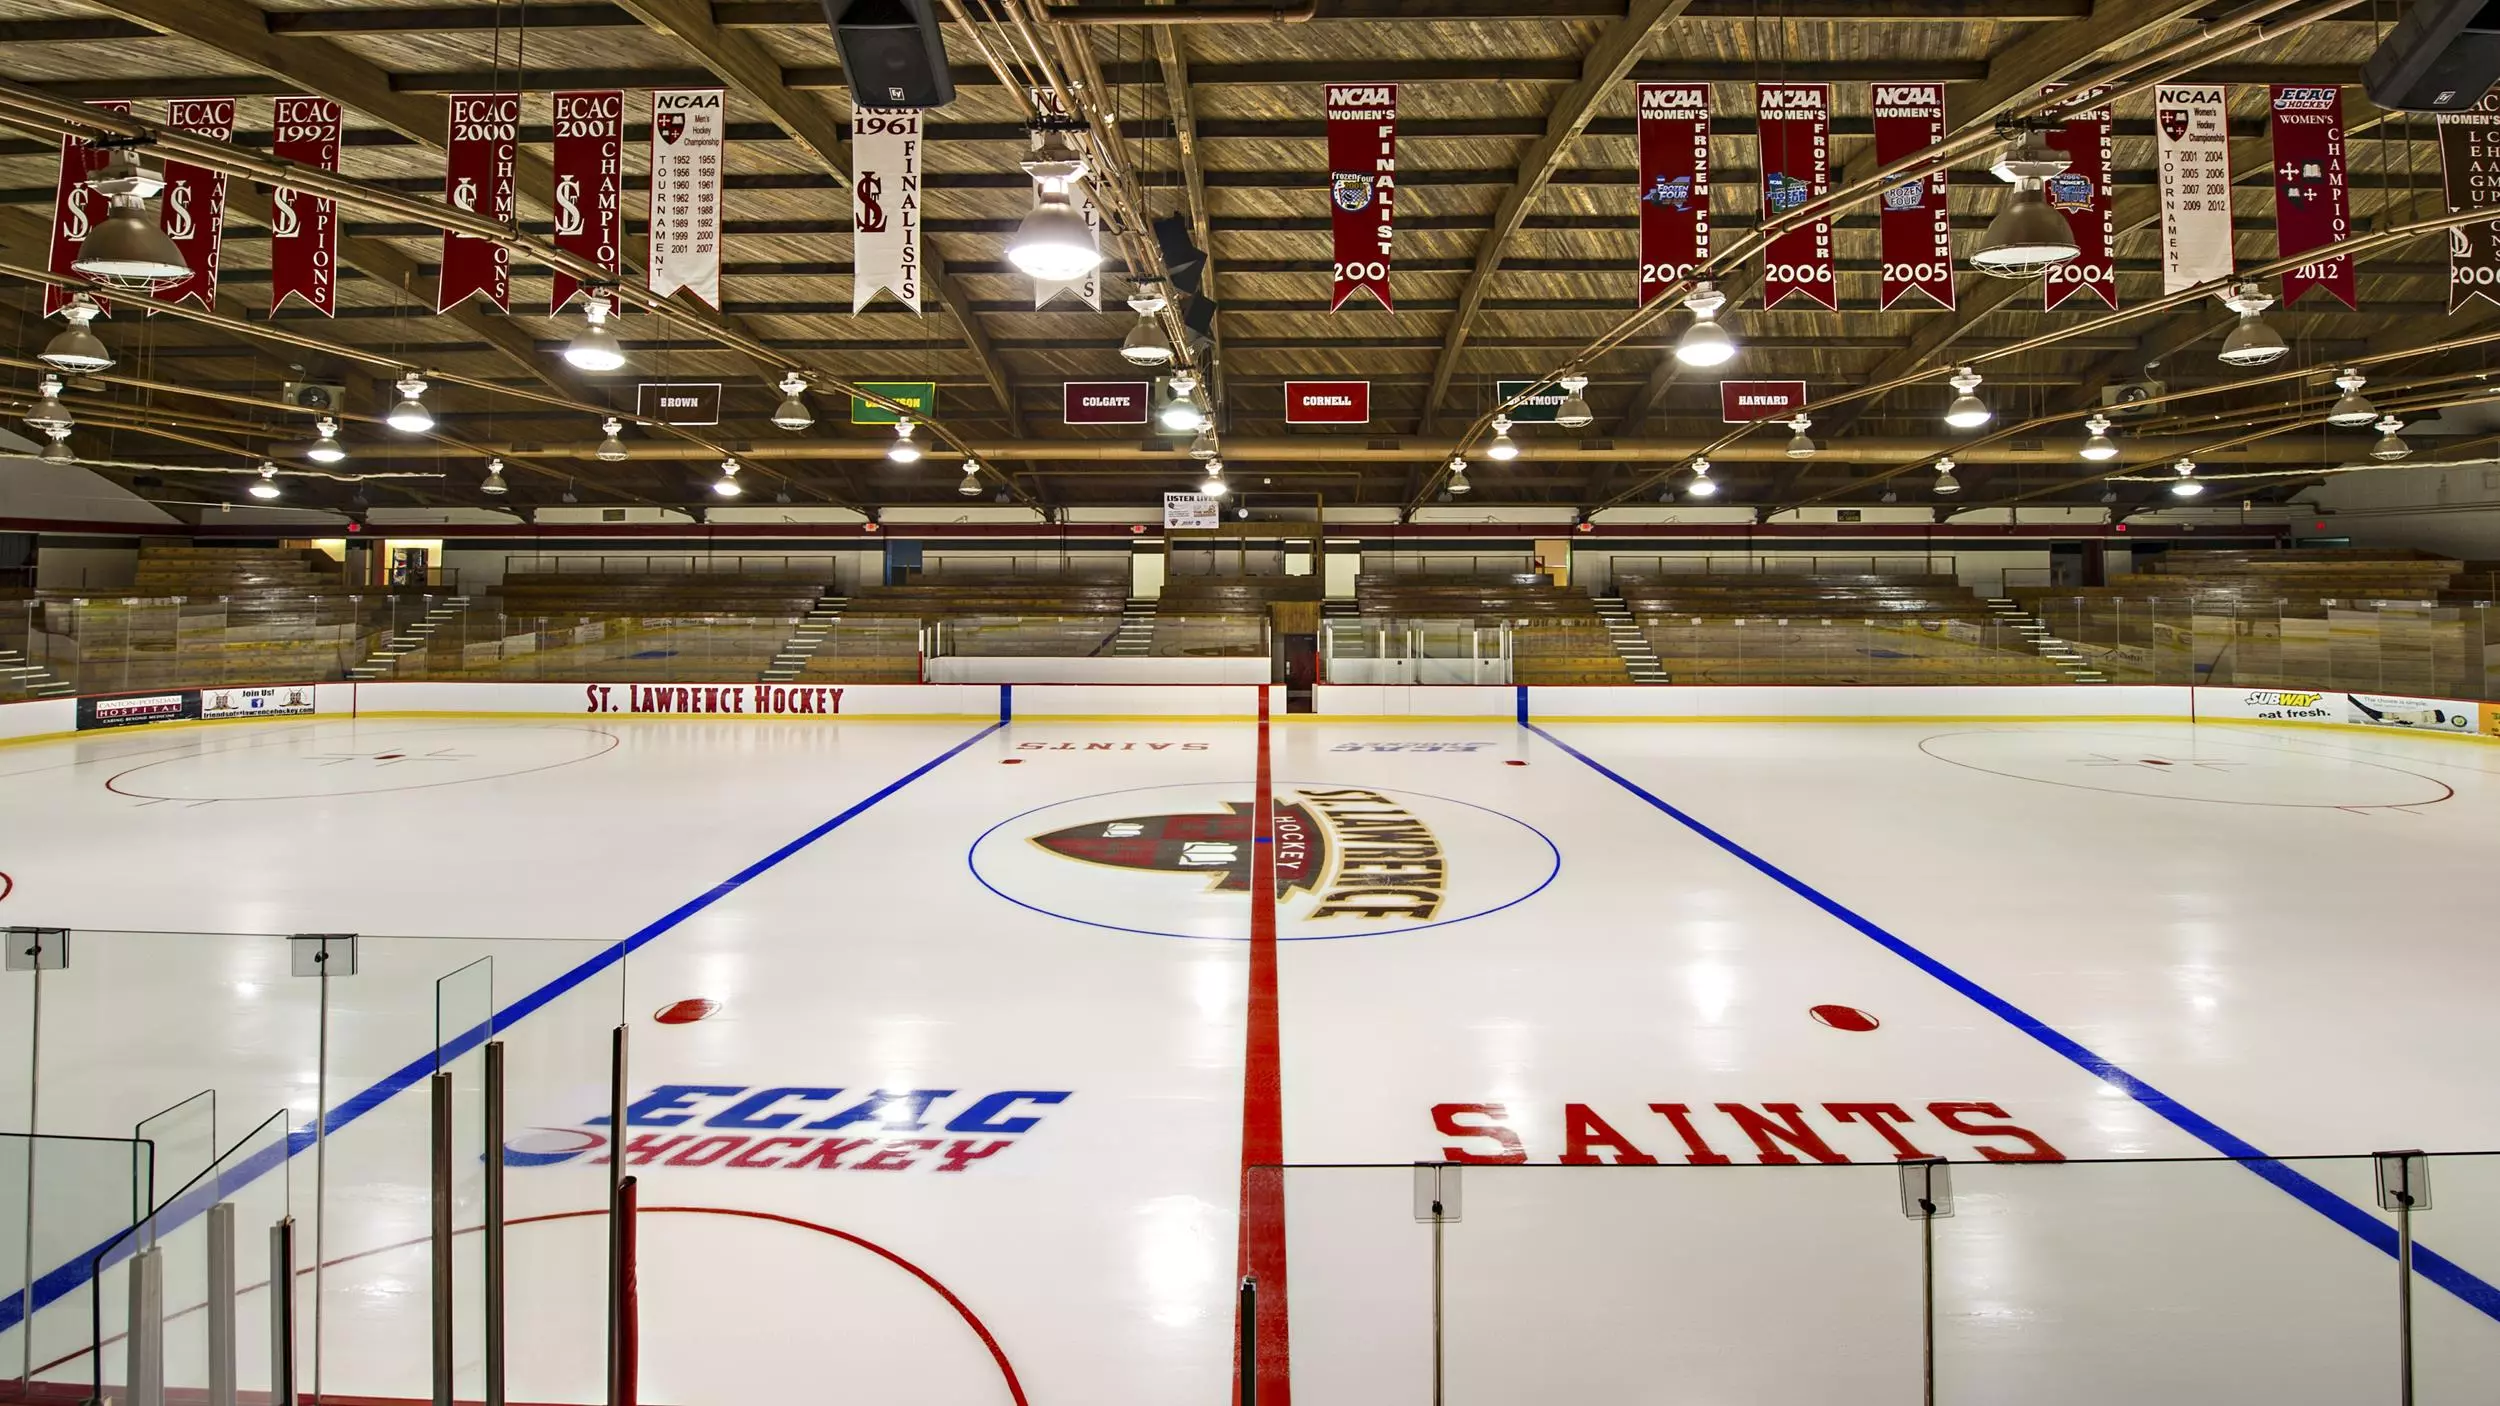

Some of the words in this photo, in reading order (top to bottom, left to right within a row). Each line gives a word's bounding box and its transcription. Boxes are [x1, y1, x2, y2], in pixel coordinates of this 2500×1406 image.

[657, 95, 720, 109] NCAA
[1328, 88, 1391, 105] NCAA
[1642, 90, 1703, 108] NCAA
[1761, 90, 1821, 108] NCAA
[1875, 87, 1937, 105] NCAA
[2159, 90, 2222, 104] NCAA
[2281, 88, 2336, 101] ECAC
[278, 101, 339, 123] ECAC
[454, 101, 517, 123] ECAC
[556, 97, 619, 119] ECAC
[2193, 107, 2217, 117] Women's
[2286, 100, 2333, 109] HOCKEY
[172, 103, 231, 125] ECAC
[694, 114, 710, 123] Men's
[1328, 109, 1395, 120] WOMEN'S
[1641, 109, 1708, 120] WOMEN'S
[1760, 109, 1826, 120] WOMEN'S
[1875, 108, 1941, 118] WOMEN'S
[2280, 114, 2334, 125] WOMEN'S
[454, 124, 515, 141] 2000
[556, 121, 616, 138] 2001
[692, 126, 712, 136] Hockey
[854, 117, 918, 135] 1961
[2196, 121, 2216, 131] Hockey
[276, 126, 336, 143] 1992
[2188, 133, 2225, 144] Championship
[683, 137, 720, 148] Championship
[673, 155, 690, 164] 1952
[698, 155, 716, 164] 1955
[1694, 123, 1708, 195] FROZEN
[1813, 124, 1828, 195] FROZEN
[2100, 124, 2113, 196] FROZEN
[2180, 151, 2198, 162] 2001
[2204, 151, 2223, 162] 2004
[1331, 171, 1357, 180] Frozen
[2182, 168, 2199, 179] 2005
[2206, 168, 2225, 179] 2006
[2469, 131, 2485, 208] LEAGU
[698, 181, 714, 189] 1961
[1376, 126, 1394, 255] FINALIST
[2182, 184, 2200, 195] 2007
[2206, 184, 2225, 195] 2008
[1658, 191, 1688, 200] FOUR
[1890, 196, 1917, 205] FOUR
[672, 206, 689, 215] 1987
[2164, 150, 2179, 273] TOURNAMENT
[2183, 200, 2201, 211] 2009
[2207, 200, 2225, 211] 2012
[655, 156, 667, 277] TOURNAMENT
[697, 218, 713, 227] 1992
[901, 140, 917, 300] FINALISTS
[671, 231, 689, 240] 1999
[696, 231, 713, 240] 2000
[1696, 210, 1708, 258] FOUR
[1816, 223, 1829, 258] OUR
[1934, 209, 1948, 257] FOUR
[2103, 210, 2114, 258] FOUR
[671, 244, 688, 254] 2001
[696, 244, 713, 253] 2007
[1334, 261, 1390, 282] 200
[1642, 263, 1699, 283] 200
[1765, 263, 1832, 283] 2006
[1883, 263, 1948, 282] 2005
[2049, 265, 2115, 284] 2004
[2294, 264, 2338, 280] 2012
[660, 397, 698, 408] BROWN
[1082, 396, 1130, 407] COLGATE
[1302, 396, 1352, 406] CORNELL
[1738, 395, 1788, 406] HARVARD
[242, 690, 260, 698] Join
[261, 689, 275, 697] Us!
[2244, 691, 2323, 707] SUBWAY
[100, 704, 178, 717] HOSPITAL
[2258, 710, 2282, 719] eat
[2286, 708, 2331, 718] fresh.
[1016, 742, 1209, 750] SAINTS
[1273, 815, 1305, 870] HOCKEY
[1310, 808, 1444, 920] LAWRENCE
[584, 1084, 1073, 1134] ECAC
[1430, 1101, 2067, 1165] SAINTS
[591, 1132, 1013, 1172] HOCKEY
